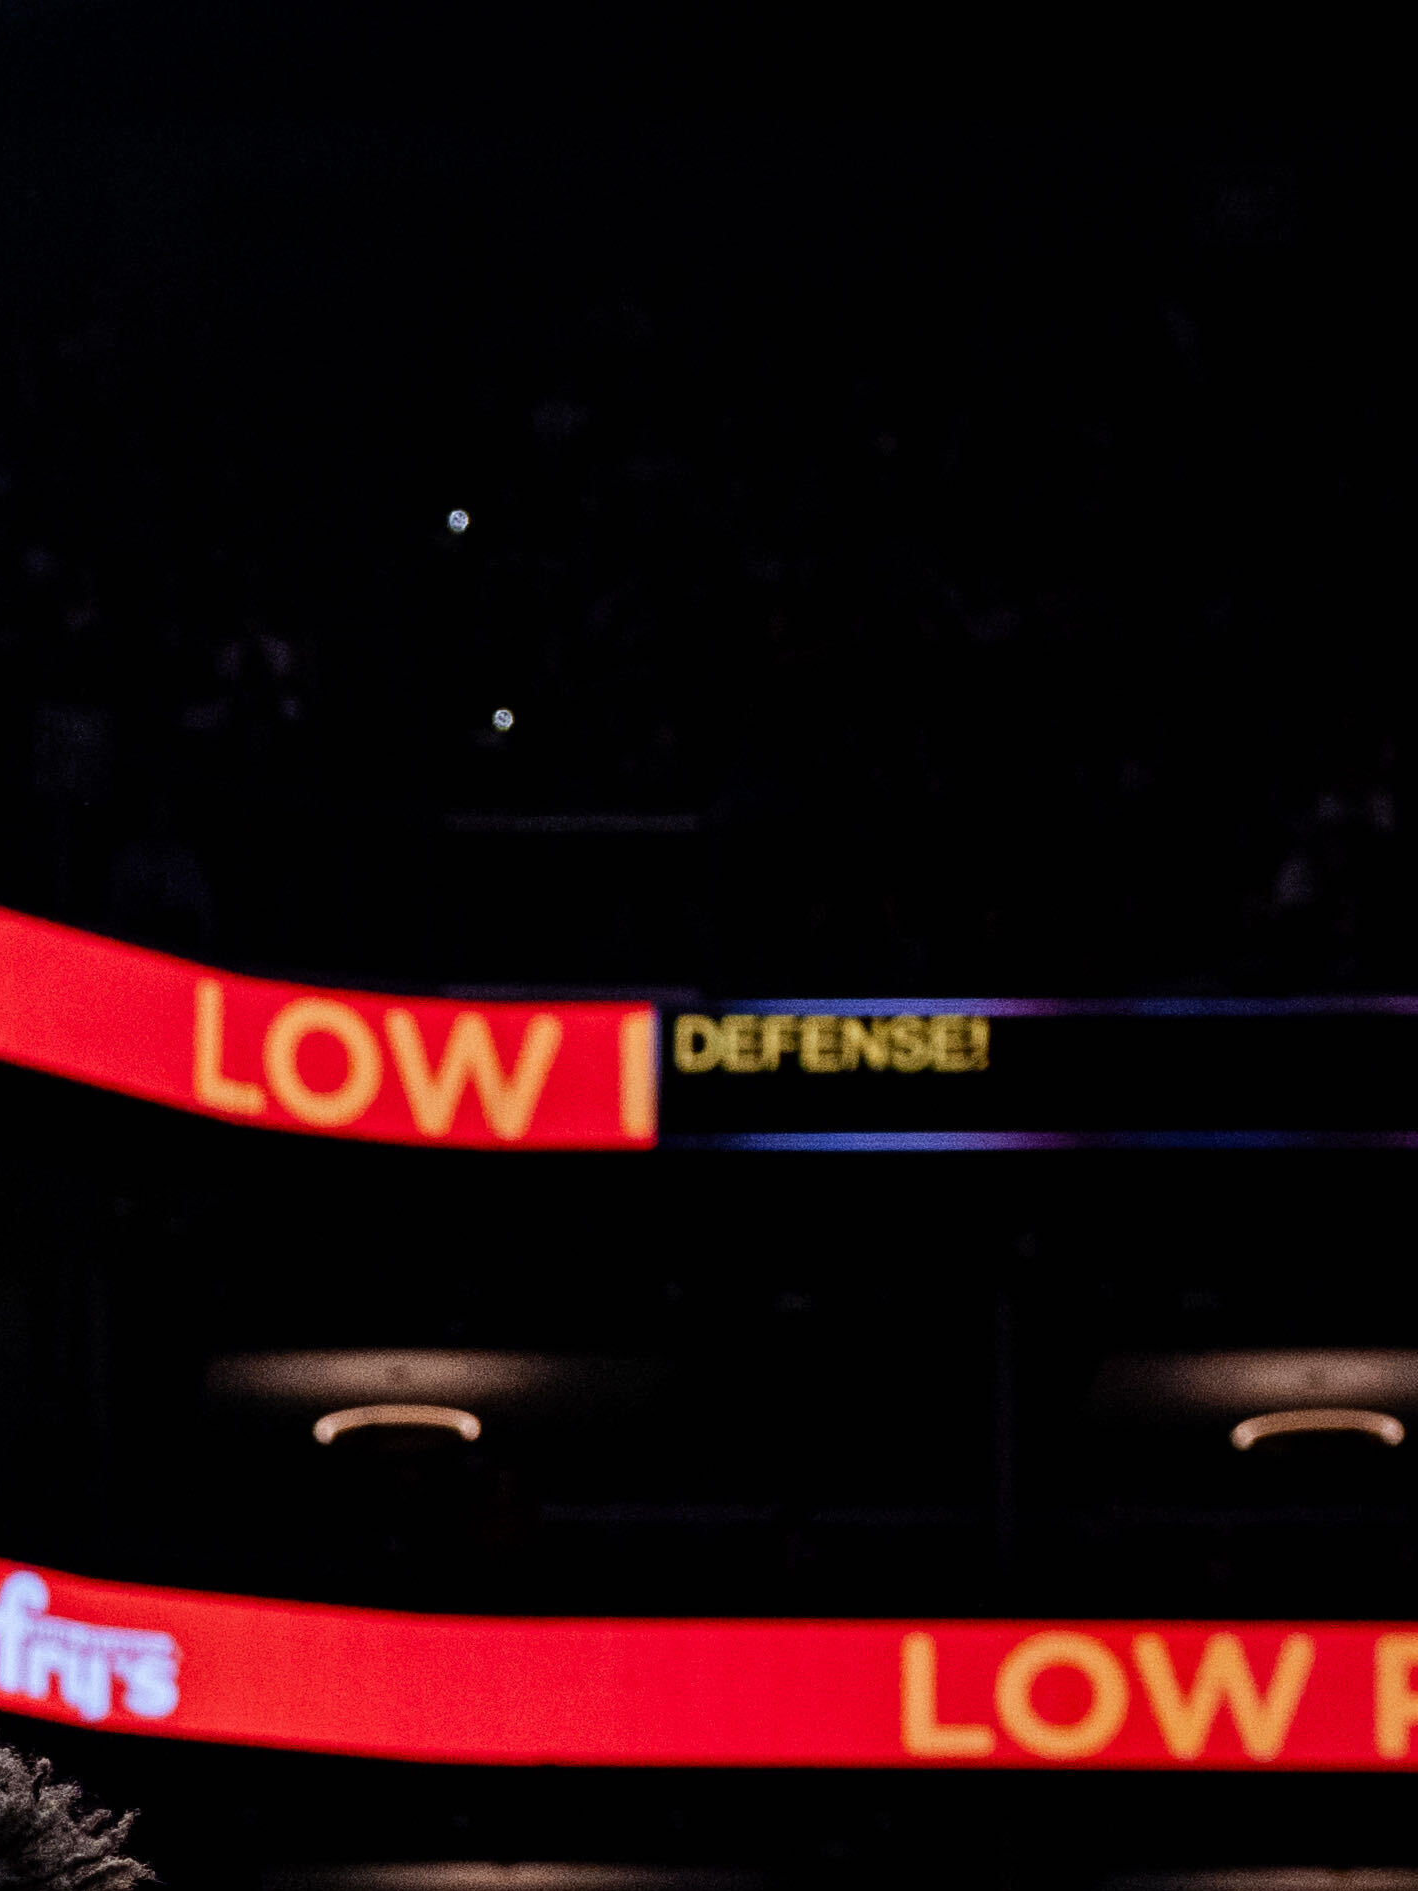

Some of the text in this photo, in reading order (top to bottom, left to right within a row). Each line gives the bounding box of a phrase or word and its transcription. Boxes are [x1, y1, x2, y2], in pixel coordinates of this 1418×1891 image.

[194, 978, 563, 1141] LOW
[674, 1014, 990, 1073] DEFENSE!
[899, 1631, 1315, 1762] LOW
